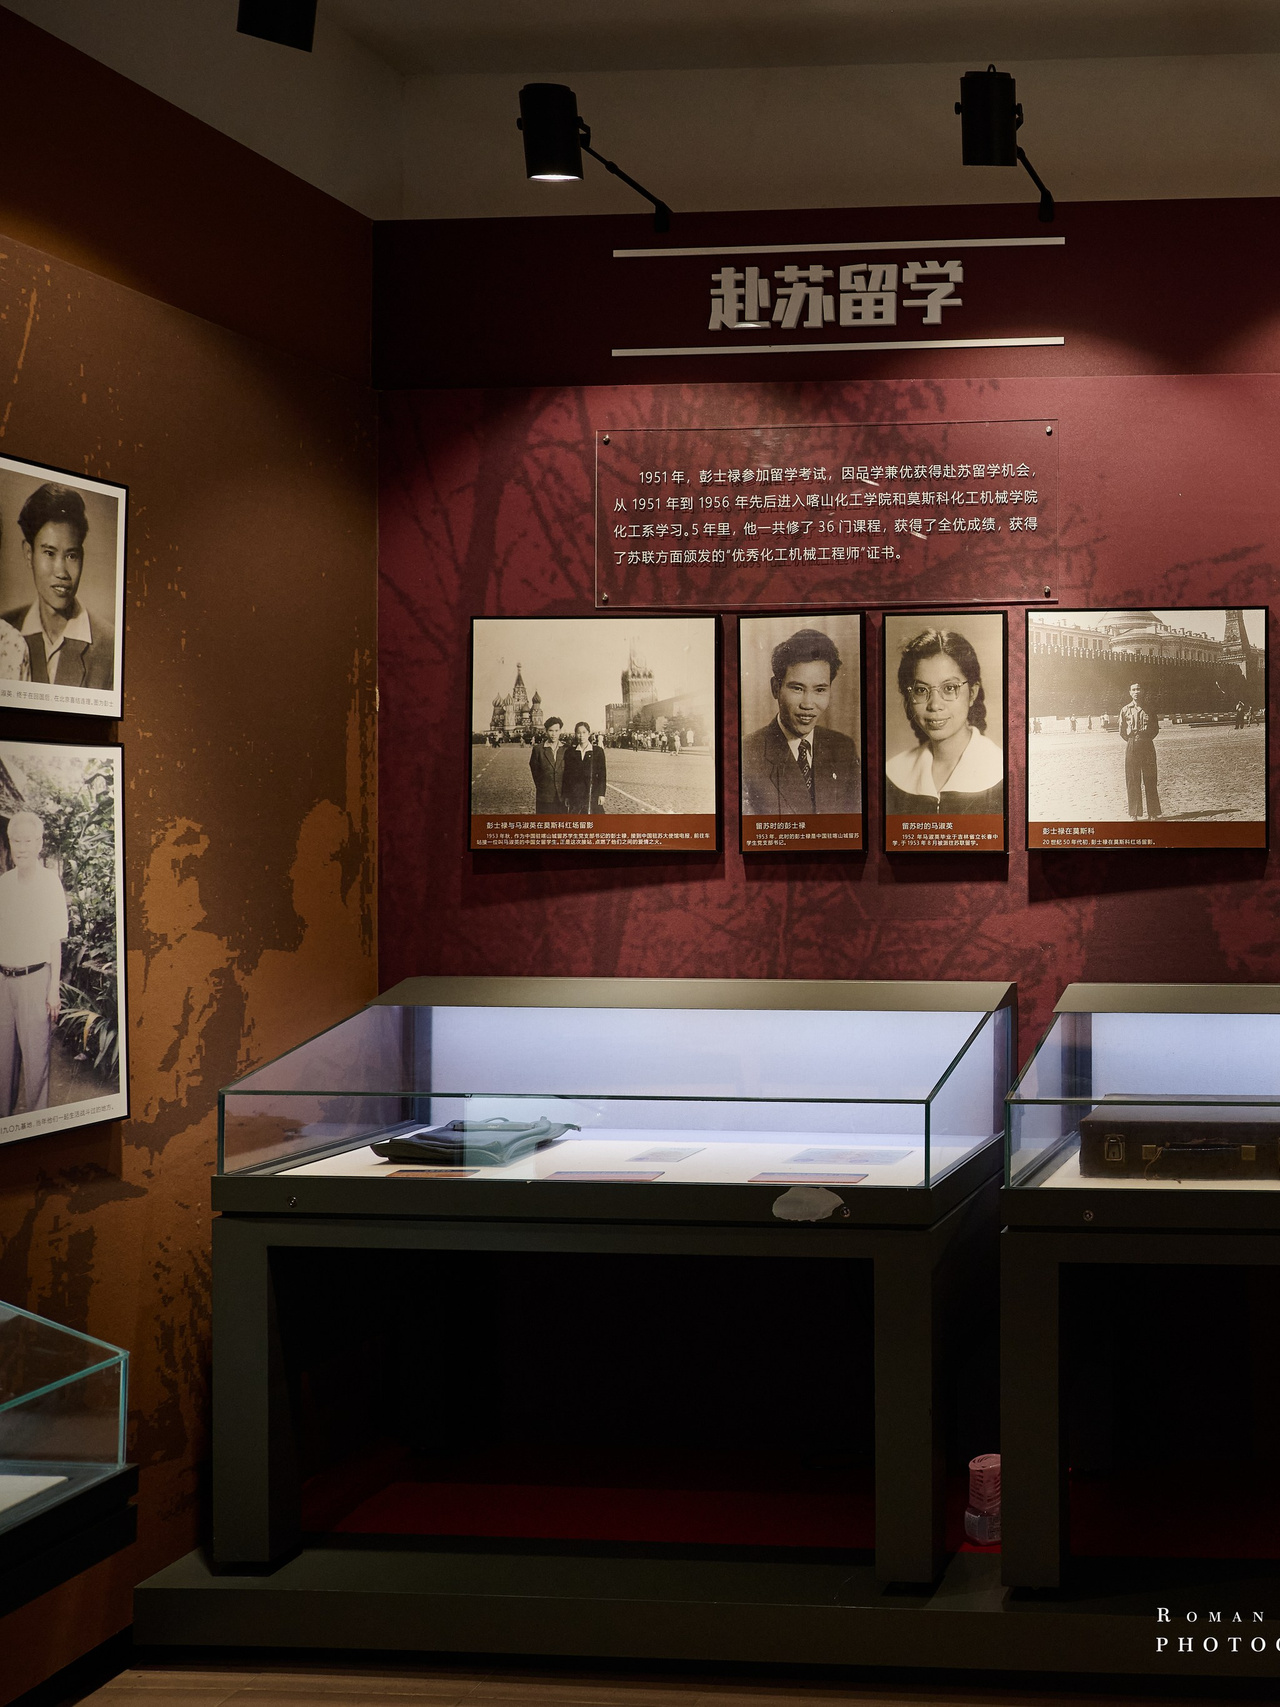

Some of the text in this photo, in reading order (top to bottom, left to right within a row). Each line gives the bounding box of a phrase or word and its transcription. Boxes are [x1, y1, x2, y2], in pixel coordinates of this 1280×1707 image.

[708, 260, 964, 331] 赴苏留学
[486, 821, 594, 830] 彭士禄与马淑英在莫斯科红场留影
[755, 821, 806, 830] 留苏时的彭士禄
[901, 822, 954, 830] 留苏时的马淑英
[1042, 827, 1095, 835] 彭士禄在莫斯科
